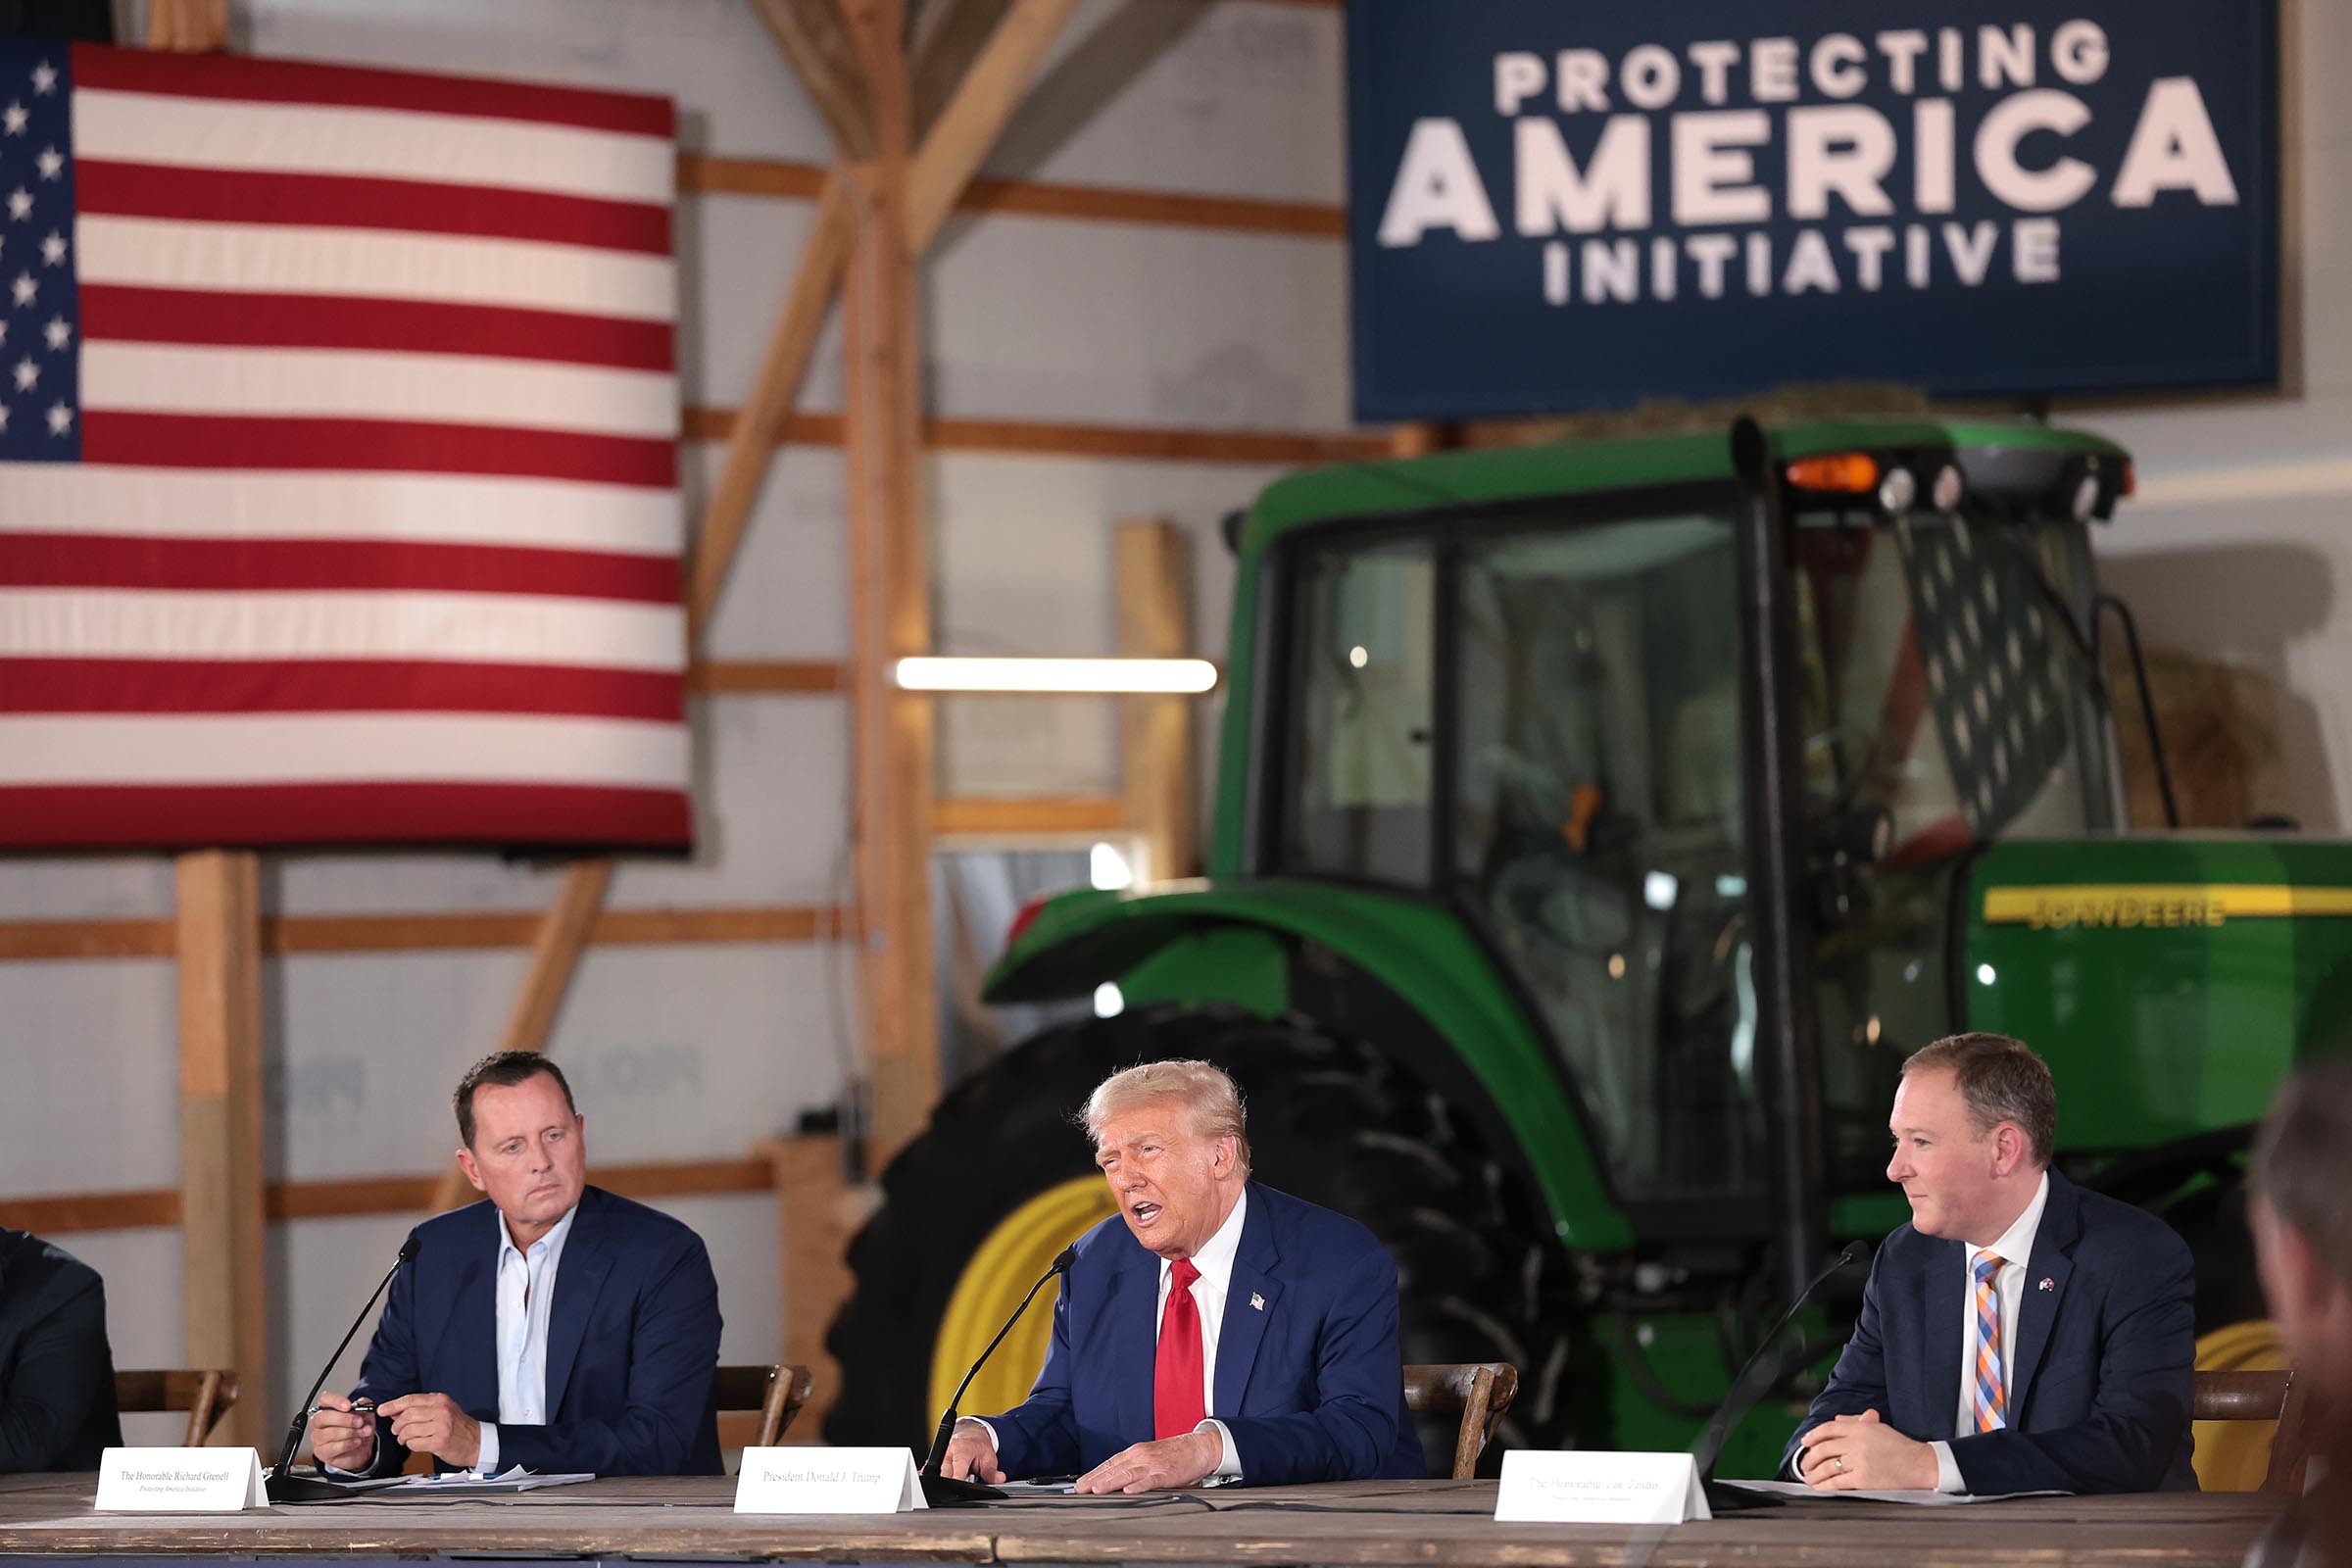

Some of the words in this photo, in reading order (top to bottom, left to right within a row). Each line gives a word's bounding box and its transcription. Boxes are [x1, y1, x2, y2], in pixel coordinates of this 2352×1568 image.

[1494, 20, 2110, 116] PROTECTING
[1377, 75, 2238, 248] AMERICA
[1544, 217, 2062, 305] INITIATIVE
[121, 1470, 134, 1481] The
[135, 1470, 172, 1481] Honorable
[173, 1470, 202, 1481] Richard
[203, 1471, 229, 1481] Grenell
[762, 1471, 804, 1482] President
[806, 1471, 839, 1482] Donald
[852, 1471, 881, 1485] Trump
